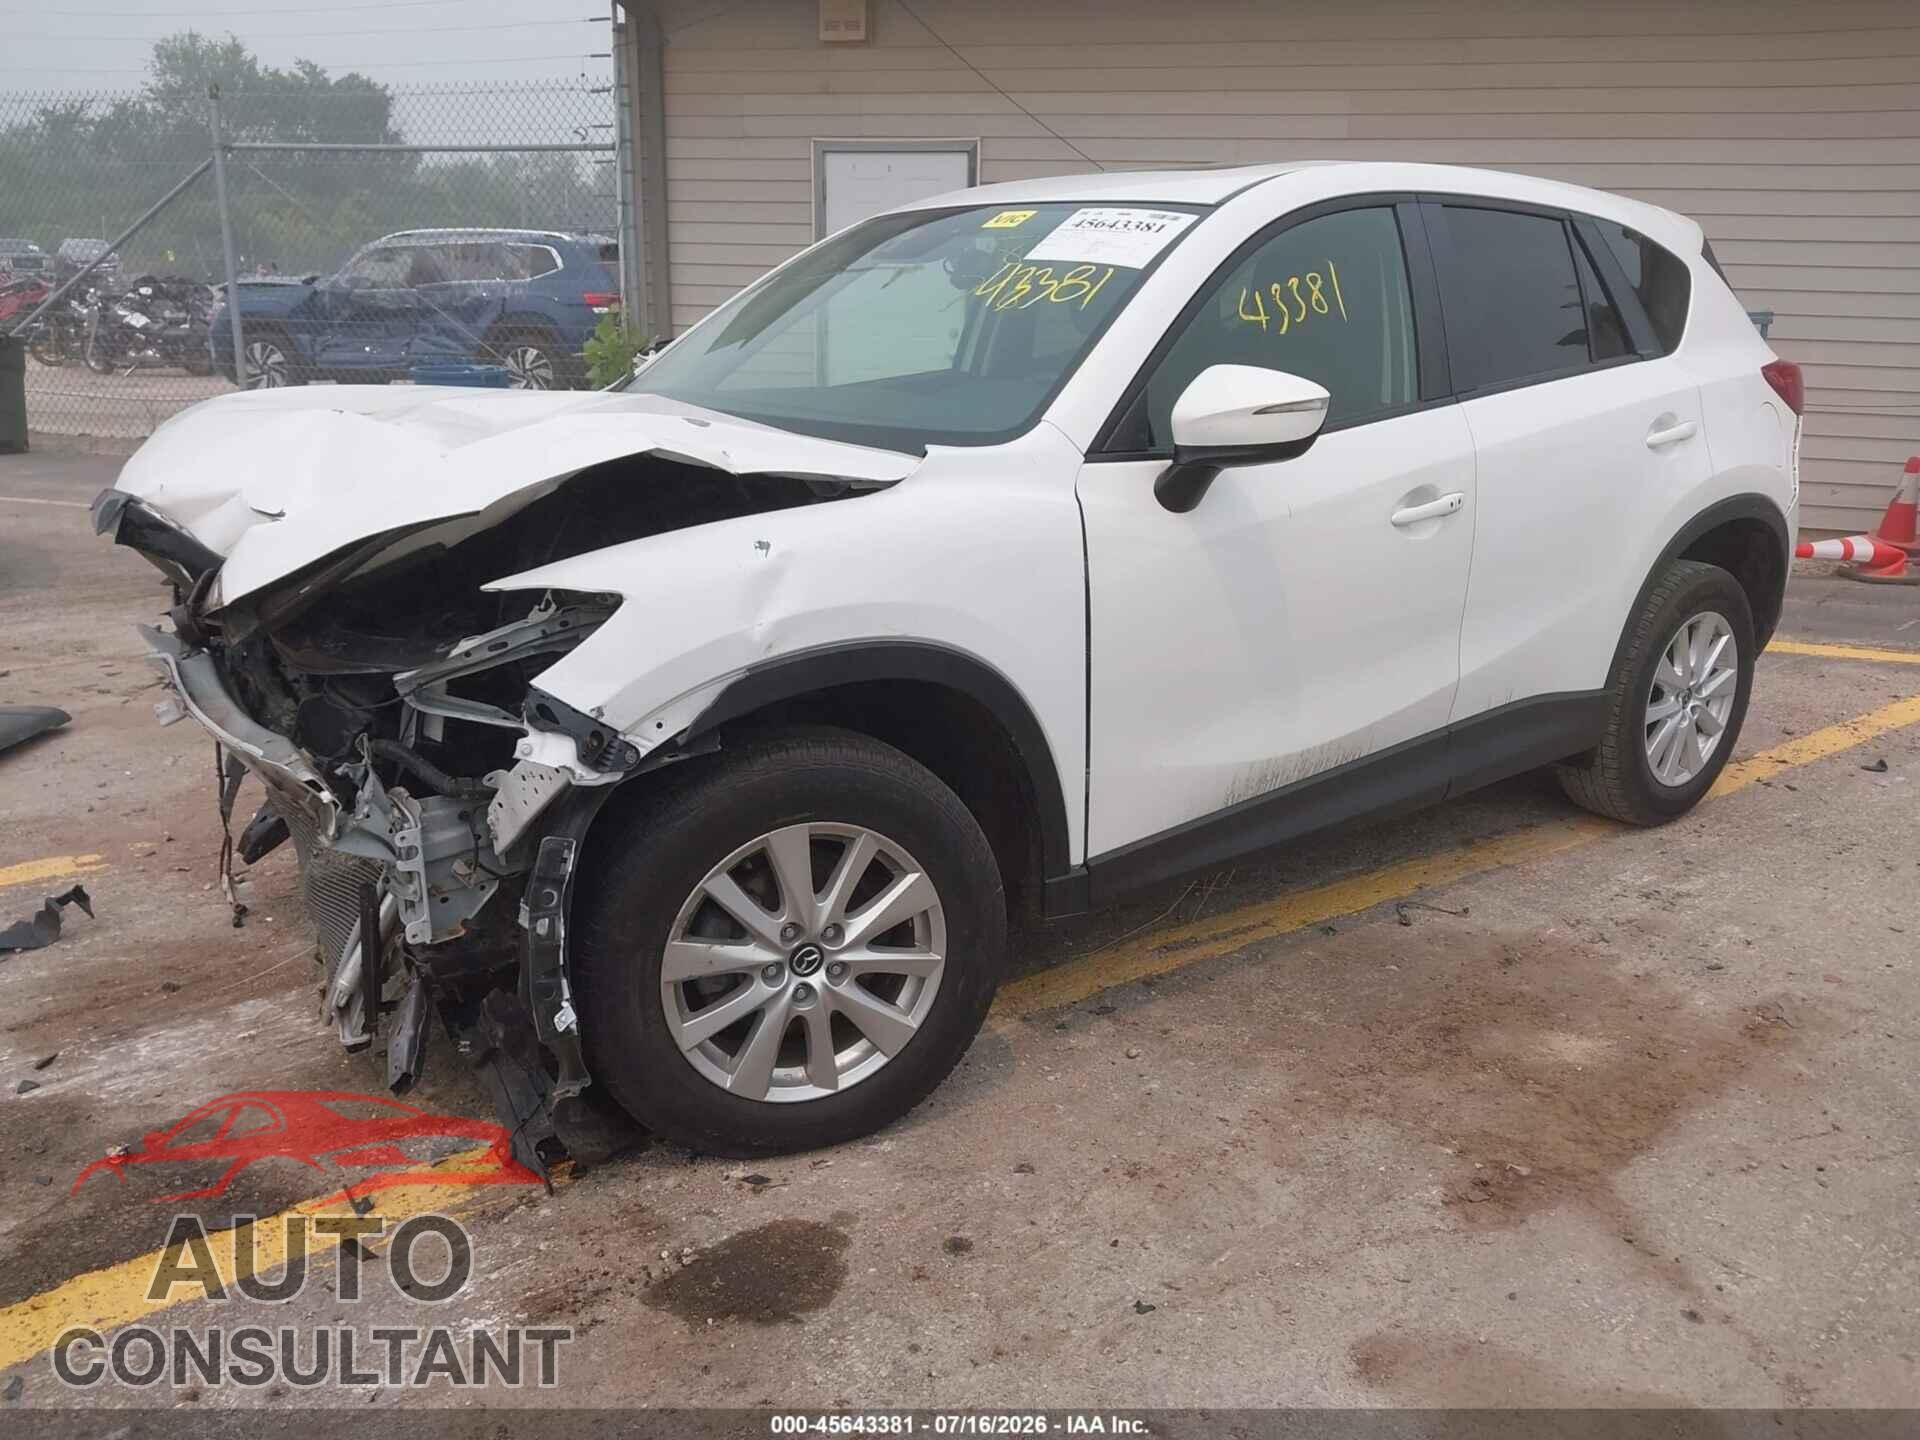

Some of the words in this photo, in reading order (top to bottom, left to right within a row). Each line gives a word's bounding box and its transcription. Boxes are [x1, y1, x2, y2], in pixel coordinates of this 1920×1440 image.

[1072, 219, 1167, 233] 45643381
[975, 263, 1114, 311] 43381
[1239, 260, 1349, 334] 43381
